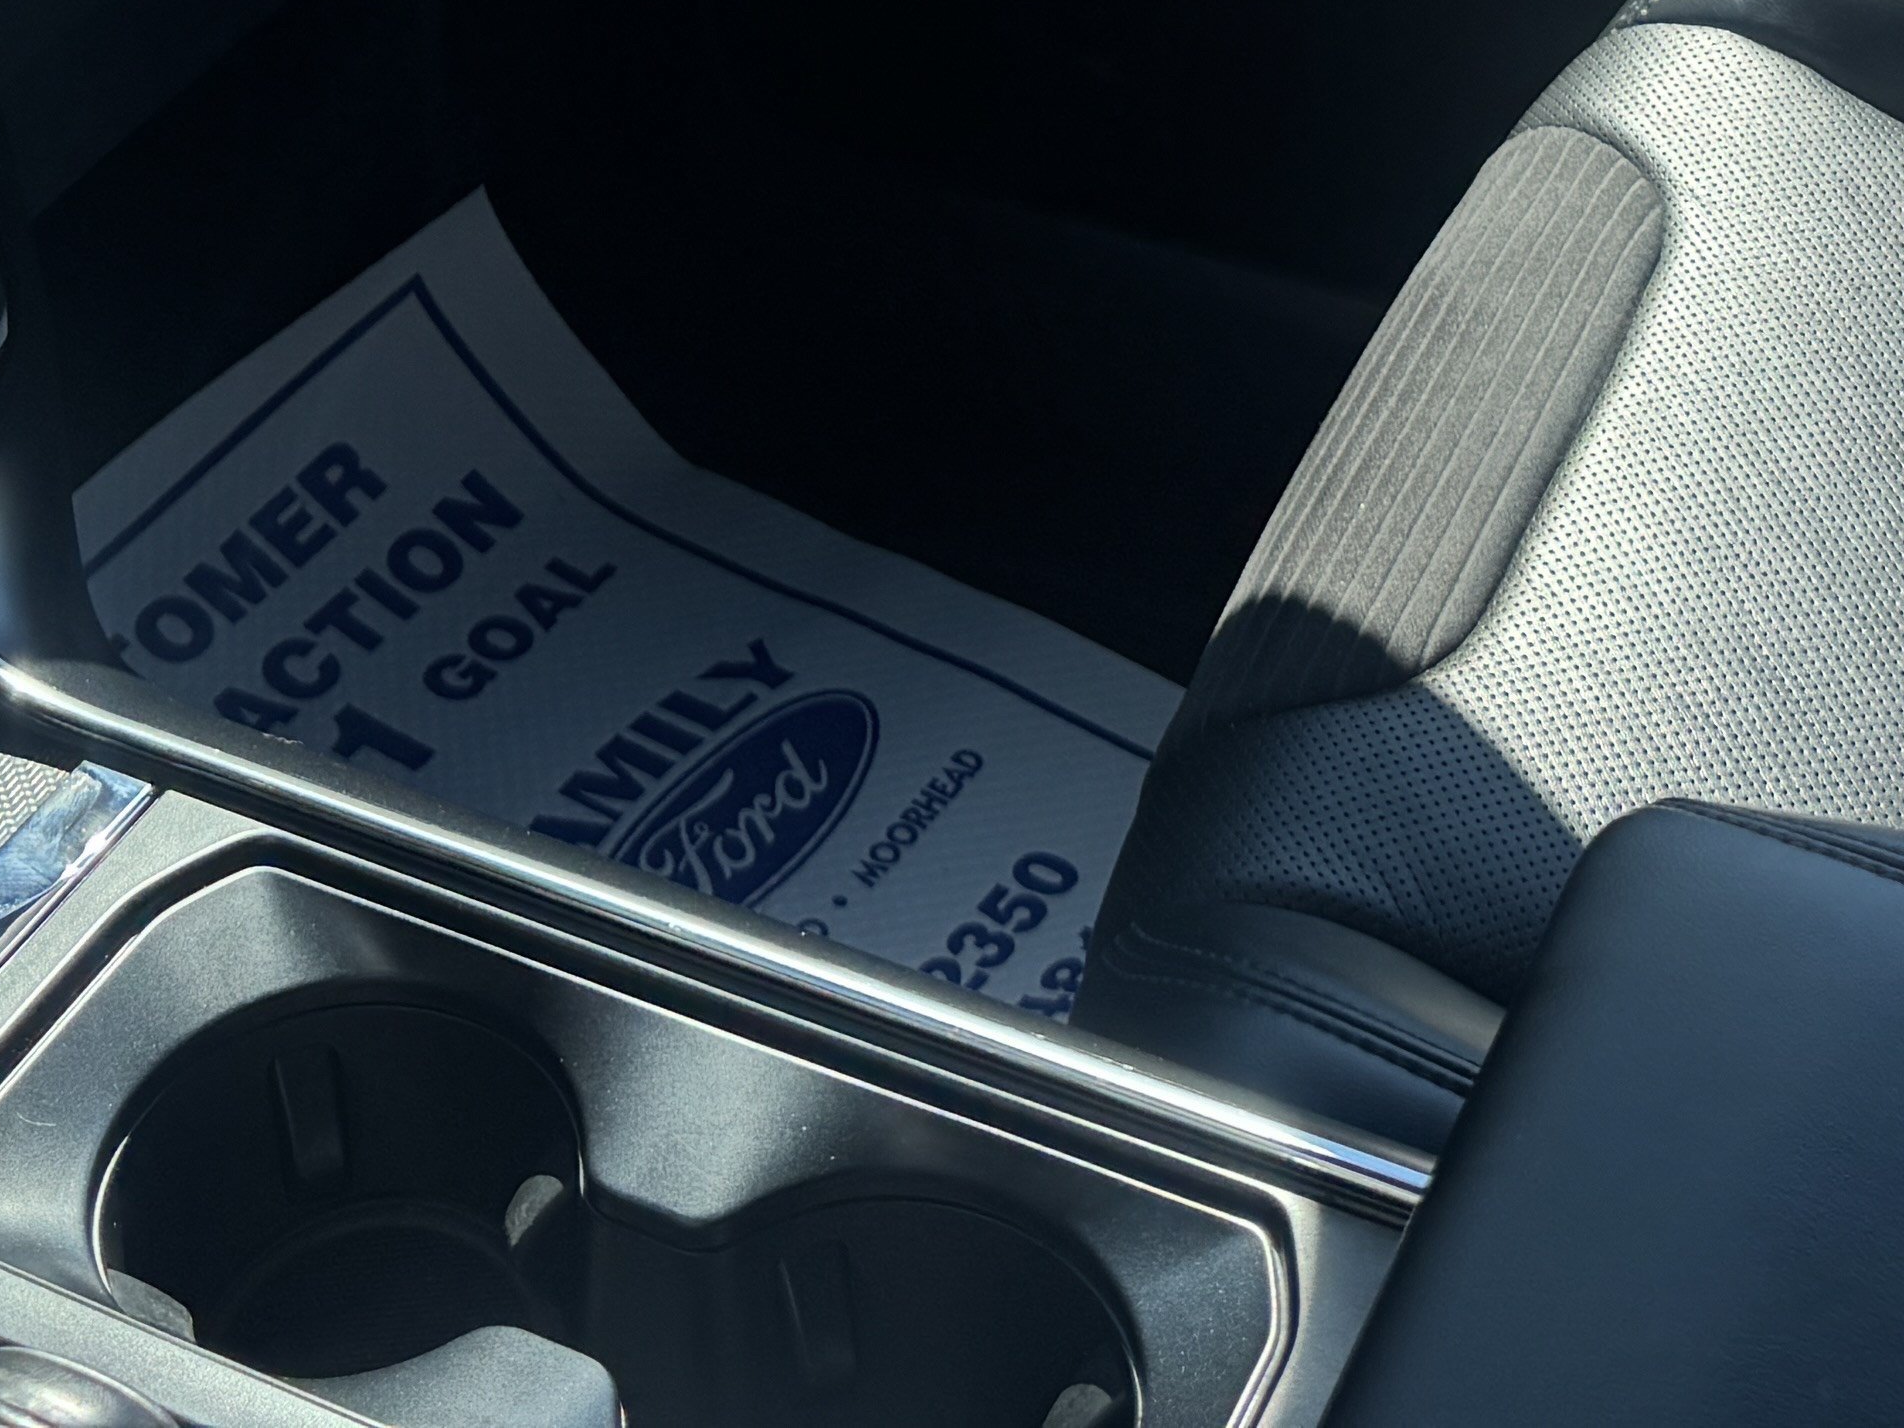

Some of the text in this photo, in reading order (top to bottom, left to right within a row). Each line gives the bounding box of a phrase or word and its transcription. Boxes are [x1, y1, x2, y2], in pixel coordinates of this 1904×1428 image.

[422, 555, 619, 702] GOAL
[639, 737, 829, 895] Ford
[849, 748, 985, 889] MOORHEAD
[915, 851, 1081, 992] 2350
